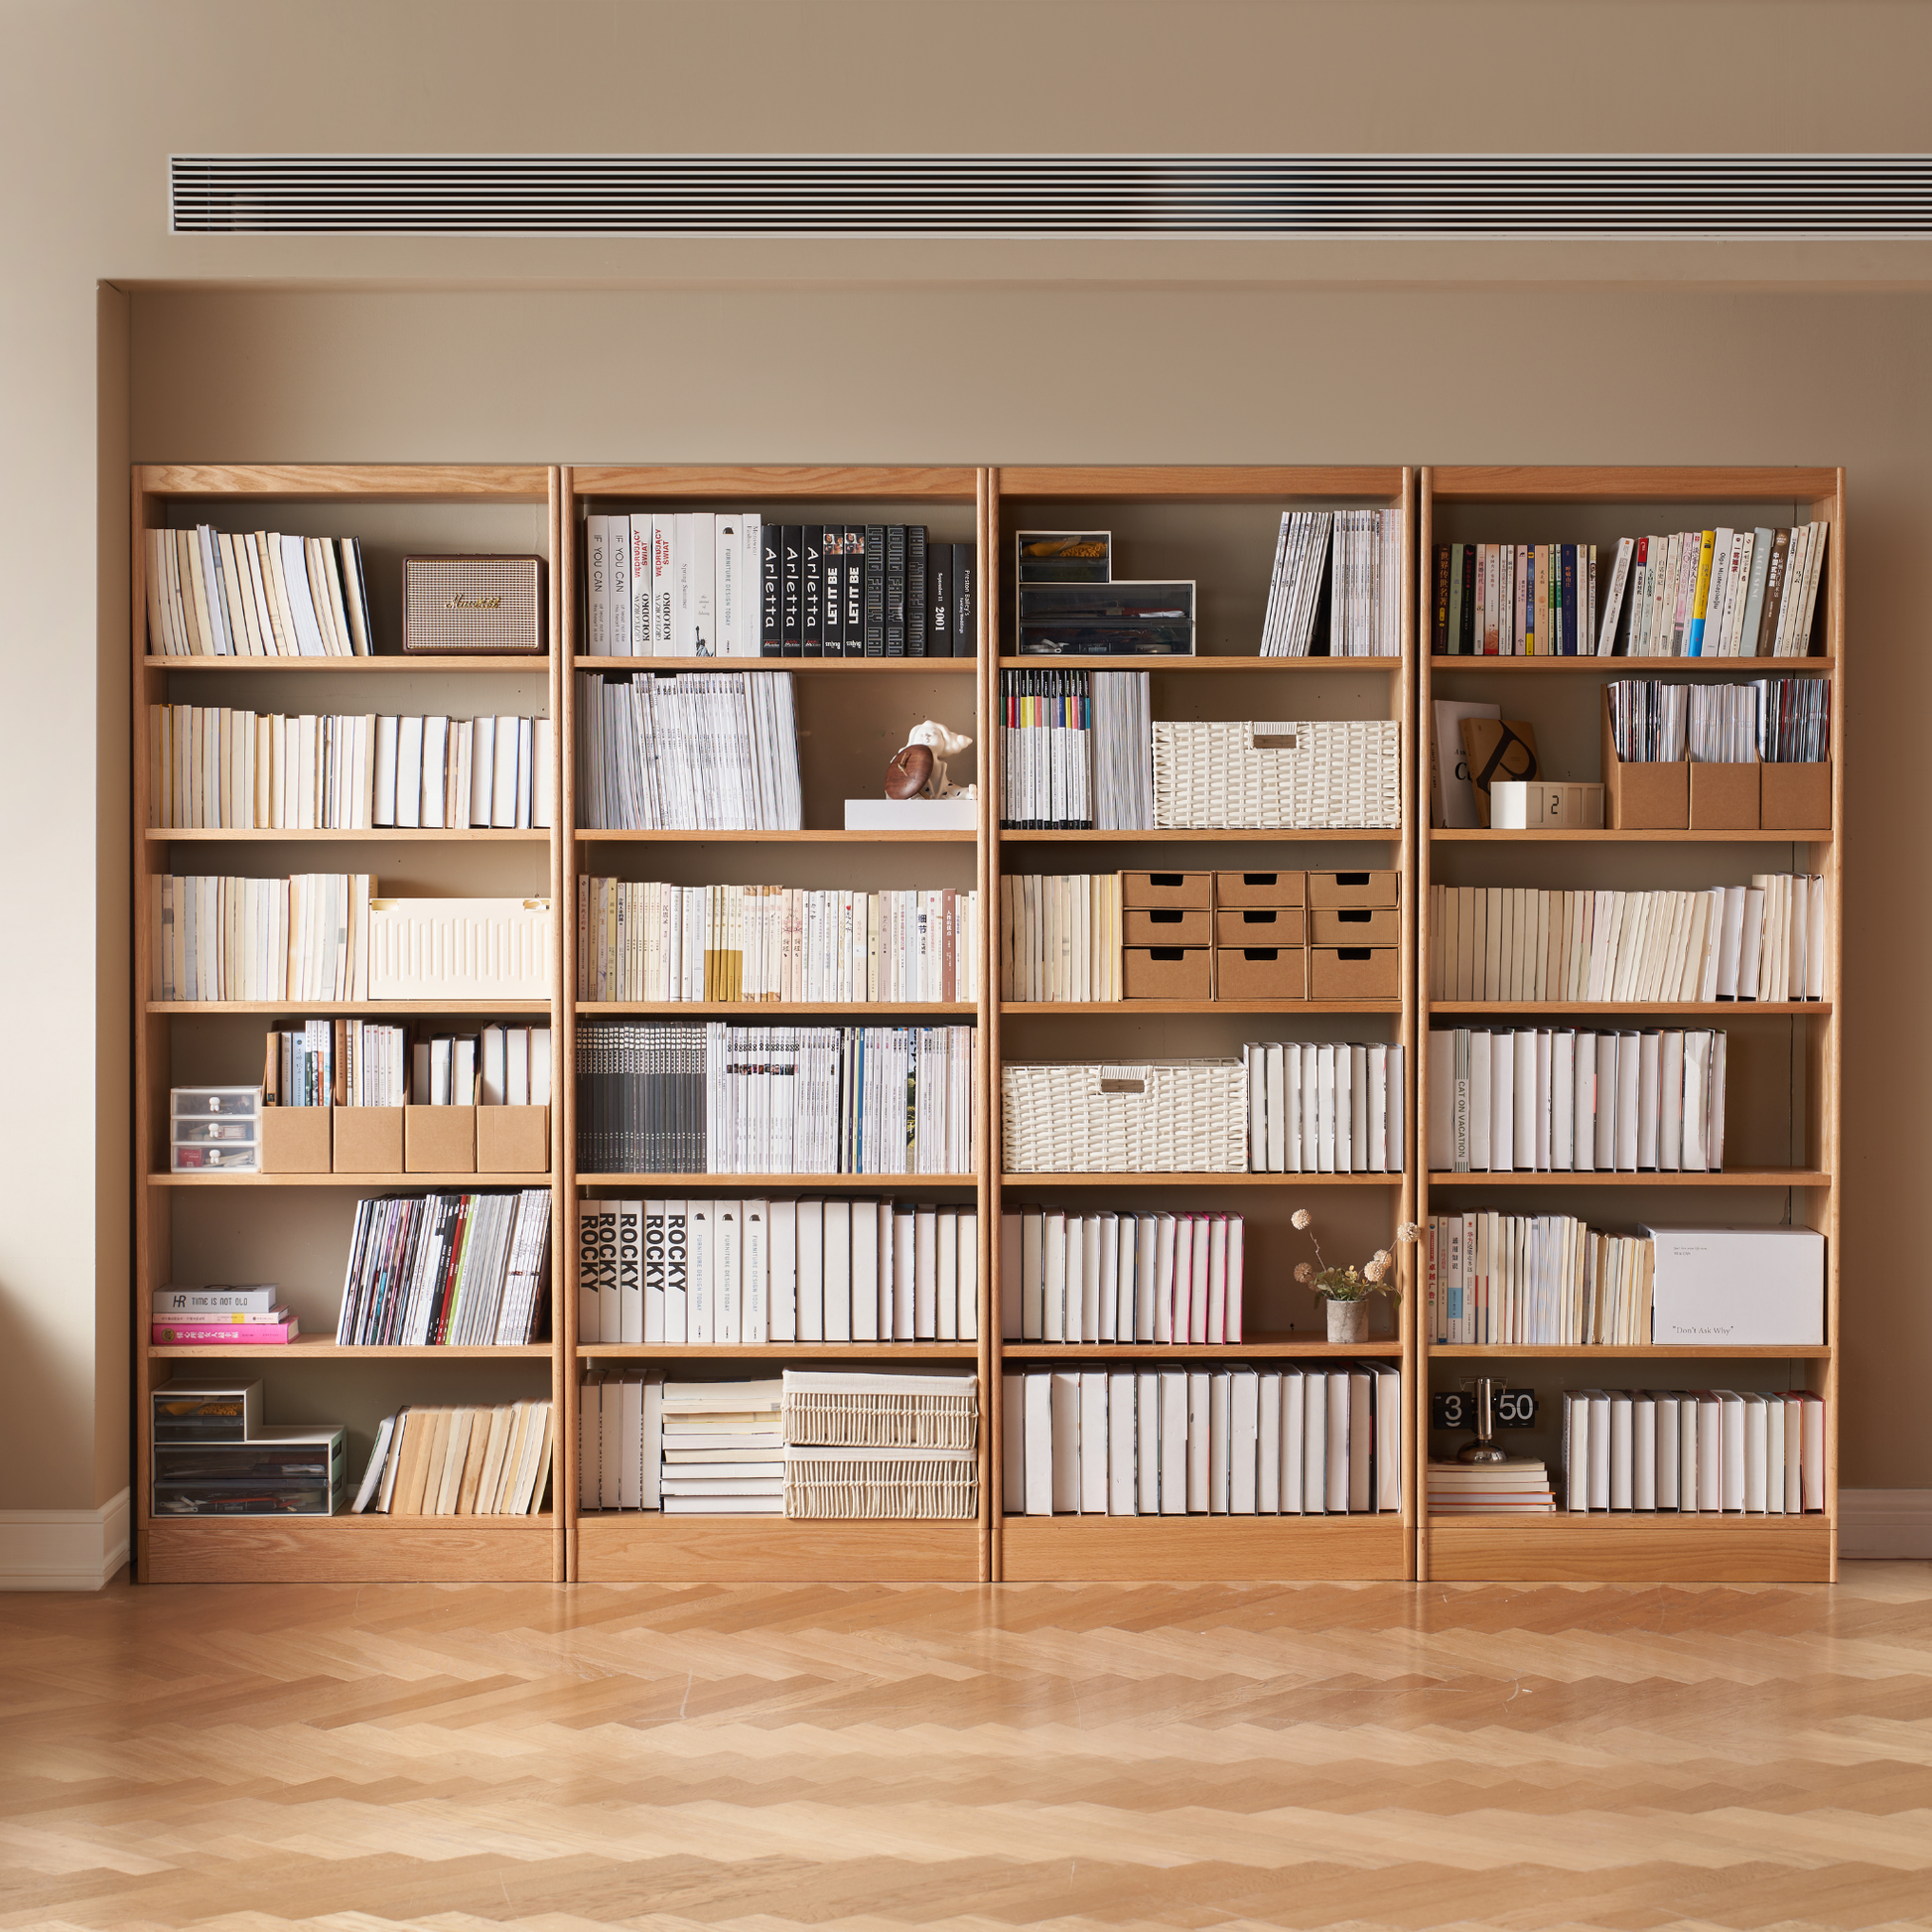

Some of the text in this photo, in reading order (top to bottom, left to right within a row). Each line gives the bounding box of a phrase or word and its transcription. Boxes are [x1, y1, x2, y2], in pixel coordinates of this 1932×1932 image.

[593, 547, 603, 567] YOU
[909, 528, 924, 557] MAN
[593, 570, 603, 592] CAN
[765, 547, 778, 628] Arletta
[786, 547, 799, 627] Arletta
[807, 547, 819, 627] Arletta
[828, 568, 837, 625] LET IT BE
[849, 567, 859, 624] LET IT BE
[868, 528, 883, 655] LOVING FAMILY MAN
[888, 528, 903, 656] LOVING FAMILY MAN
[909, 562, 924, 608] FAMILY
[935, 607, 944, 630] 2001
[1551, 795, 1559, 814] 2
[918, 914, 927, 934] 细节
[1458, 1100, 1465, 1112] ON
[581, 1215, 598, 1293] ROCKY
[599, 1213, 616, 1290] ROCKY
[621, 1214, 638, 1291] ROCKY
[646, 1215, 664, 1292] ROCKY
[668, 1215, 686, 1292] ROCKY
[192, 1297, 208, 1305] TIME
[211, 1297, 217, 1305] IS
[235, 1297, 248, 1305] OLD
[1445, 1395, 1462, 1420] 3
[1499, 1394, 1533, 1420] 50
